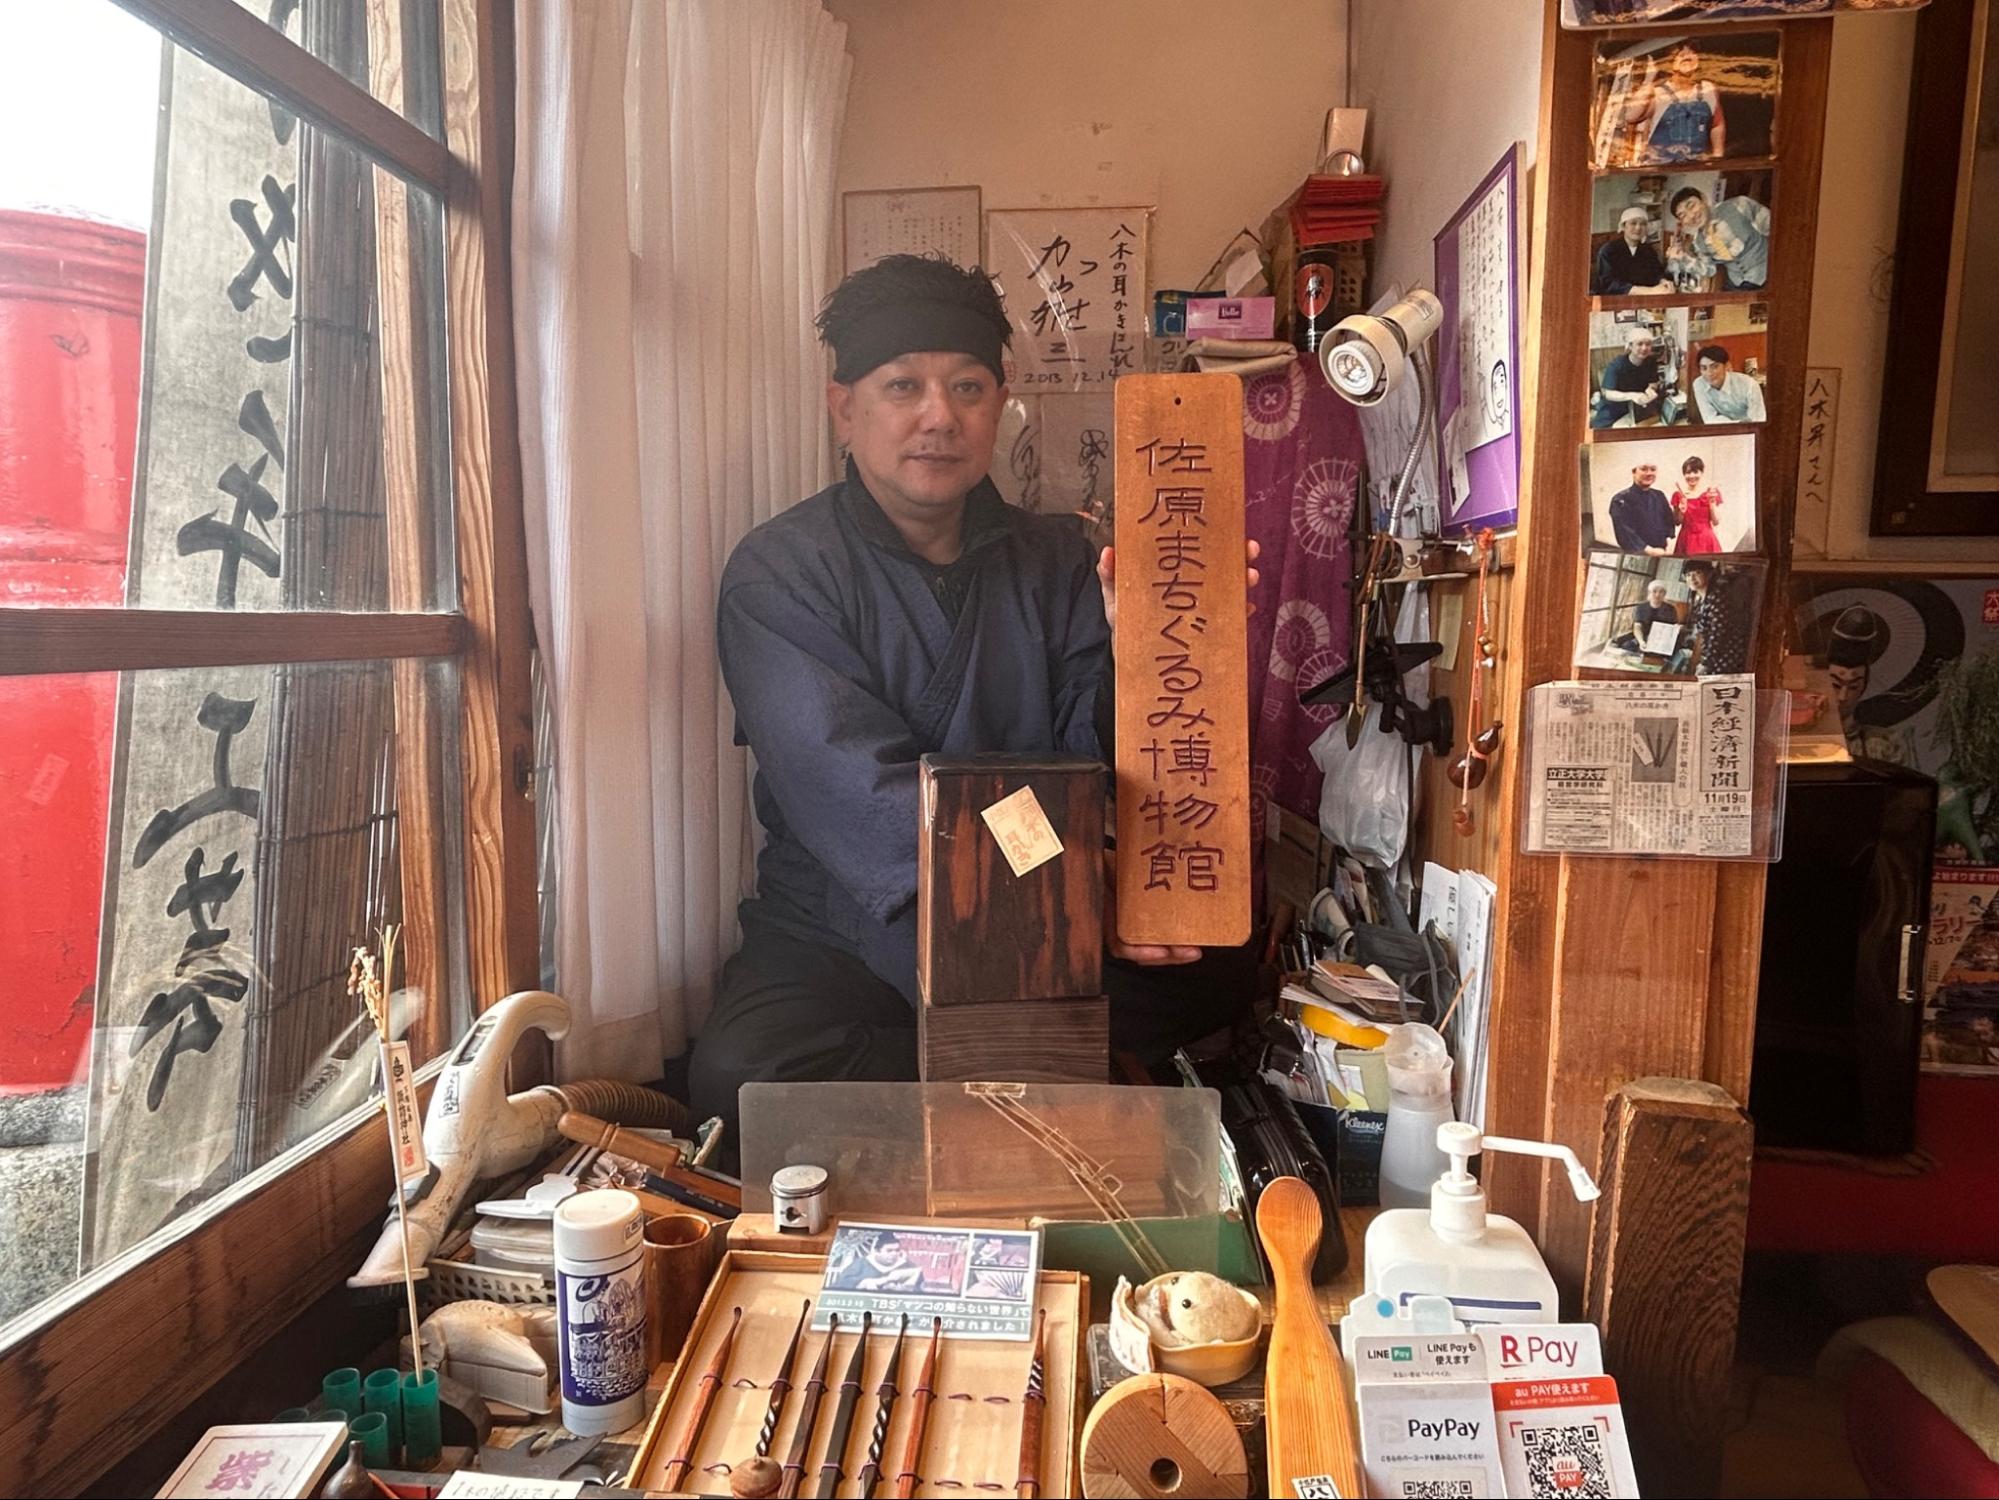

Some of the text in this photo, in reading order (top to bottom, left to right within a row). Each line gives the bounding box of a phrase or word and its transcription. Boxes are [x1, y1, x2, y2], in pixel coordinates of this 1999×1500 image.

[1136, 438, 1225, 892] 佐原まちぐるみ博物館
[1706, 686, 1745, 788] 日本経済新聞
[1367, 1349, 1412, 1360] LINE Pay
[1427, 1343, 1449, 1354] LINE
[1528, 1336, 1578, 1367] Pay
[1435, 1354, 1471, 1366] 使えます
[1515, 1387, 1529, 1397] au
[1408, 1418, 1481, 1441] PayPay
[1555, 1459, 1576, 1471] au
[1559, 1473, 1578, 1484] PAY
